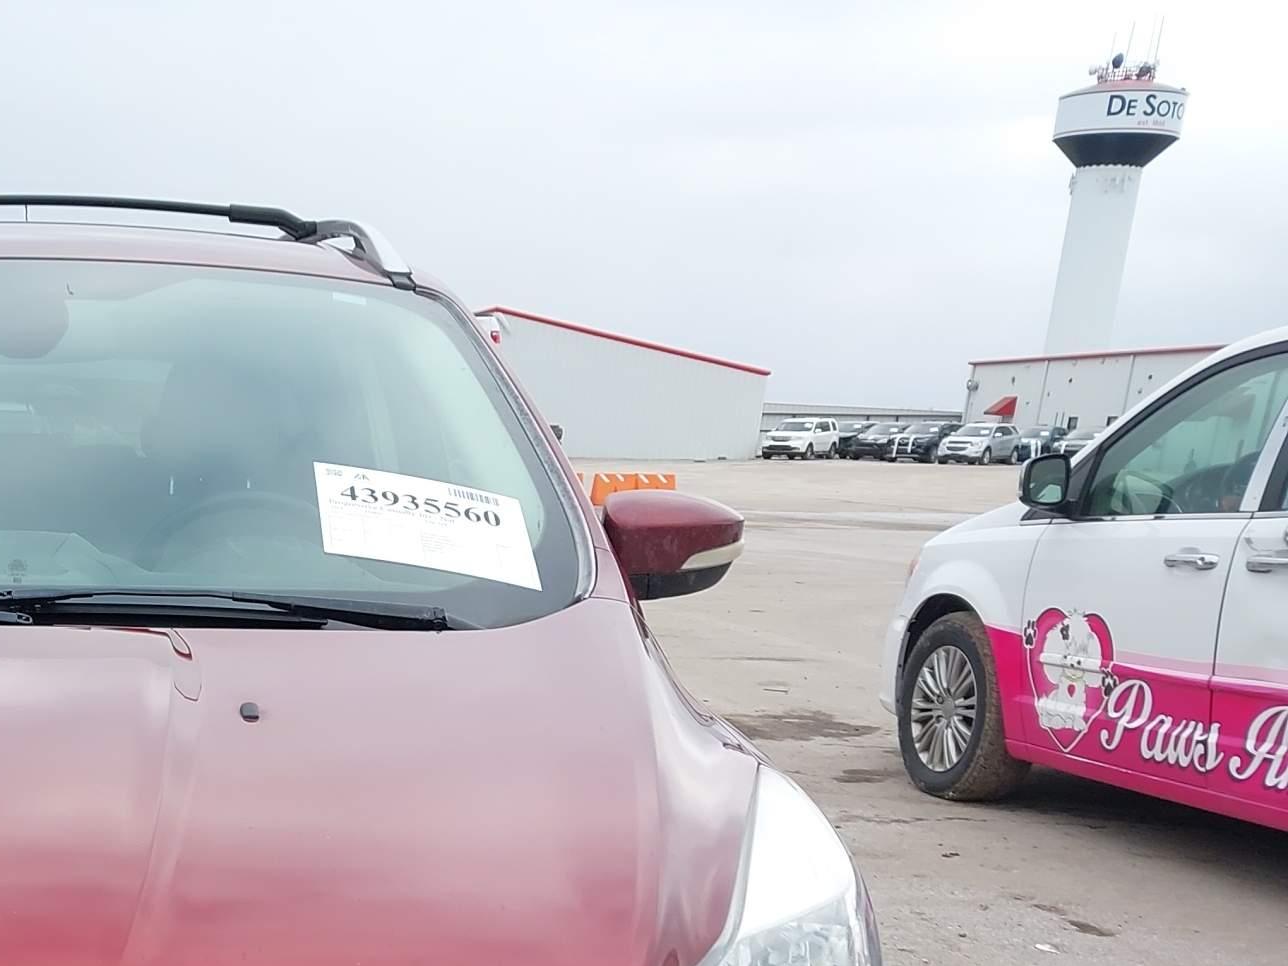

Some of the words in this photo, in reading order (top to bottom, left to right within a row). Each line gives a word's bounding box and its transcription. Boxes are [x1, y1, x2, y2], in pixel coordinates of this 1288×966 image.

[340, 485, 501, 527] 43935560
[1100, 679, 1224, 772] Paws
[1228, 704, 1288, 790] A
